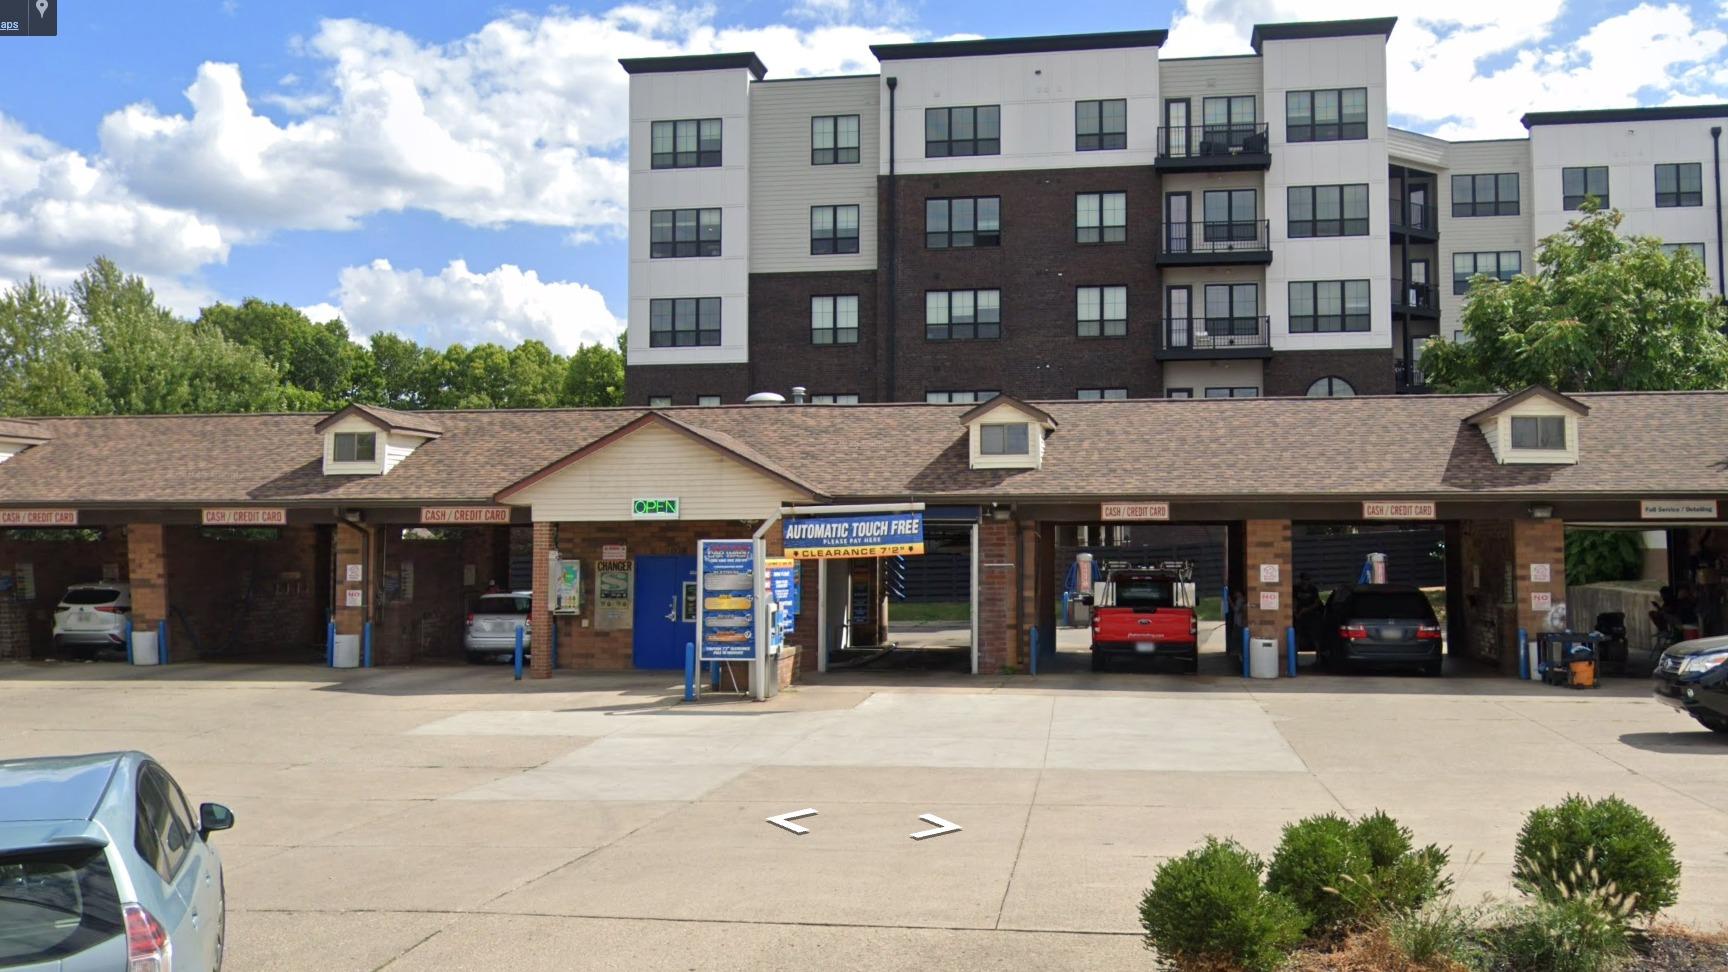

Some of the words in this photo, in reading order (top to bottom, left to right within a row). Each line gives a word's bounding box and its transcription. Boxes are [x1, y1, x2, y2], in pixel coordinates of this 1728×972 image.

[634, 500, 677, 514] OPEN
[1105, 506, 1120, 516] CASH
[1126, 506, 1148, 516] CREDIT
[1150, 506, 1166, 516] CARD
[1367, 504, 1384, 516] CASH
[1391, 504, 1413, 516] CREDIT
[1414, 504, 1432, 516] CARD
[2, 512, 20, 522] CASH
[28, 512, 53, 522] CREDIT
[54, 512, 74, 522] CARD
[206, 512, 225, 522] CASH
[234, 511, 260, 522] CREDIT
[262, 511, 282, 522] CARD
[425, 510, 446, 520] CASH
[454, 510, 482, 520] CREDIT
[484, 510, 506, 520] CARD
[786, 522, 849, 540] AUTOMATIC
[852, 520, 888, 537] TOUCH
[891, 518, 920, 535] FREE
[802, 548, 876, 558] CLEARANCE
[880, 546, 905, 555] 7'2"
[598, 562, 632, 572] CHANGER
